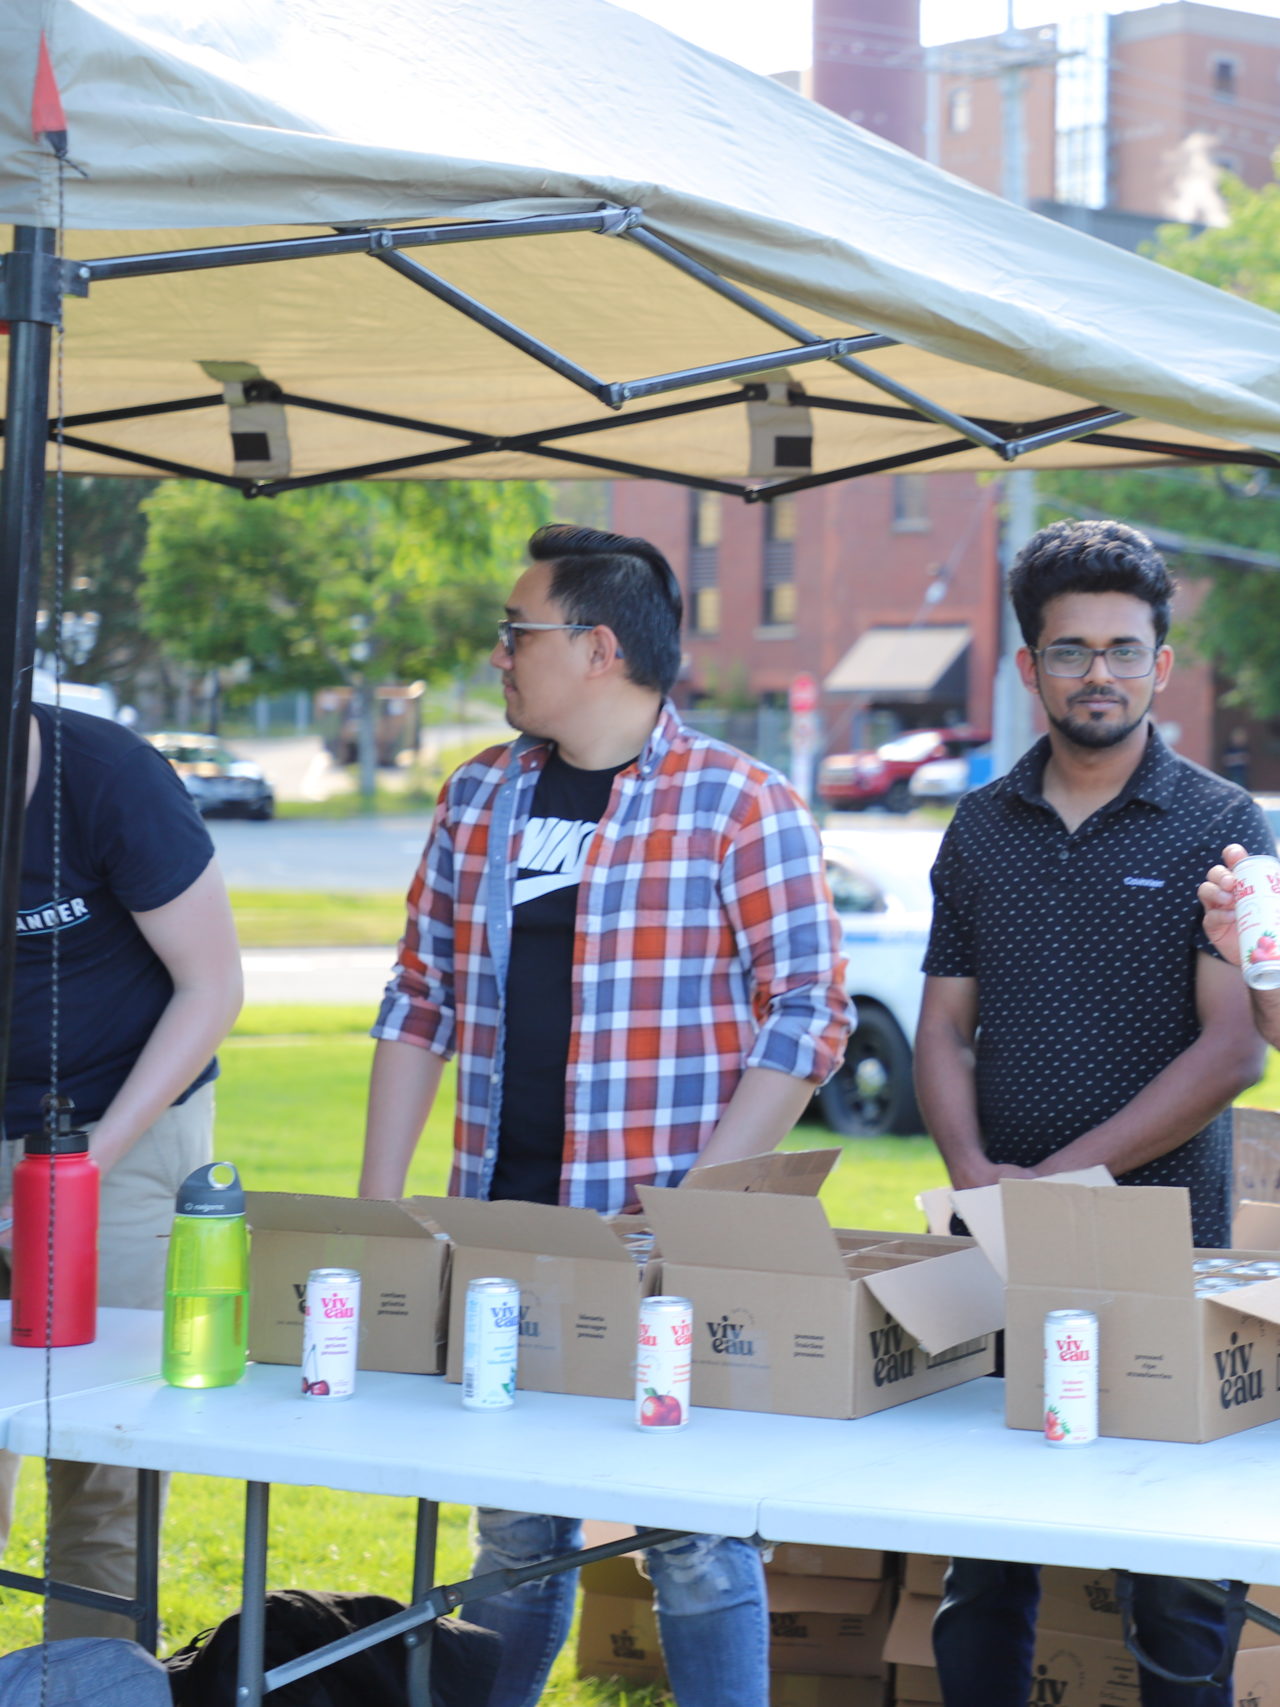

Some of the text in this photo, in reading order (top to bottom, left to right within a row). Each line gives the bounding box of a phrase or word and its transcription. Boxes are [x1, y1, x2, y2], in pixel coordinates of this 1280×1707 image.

[321, 1293, 350, 1308] viv
[490, 1301, 516, 1318] viv
[324, 1306, 355, 1319] eau
[706, 1315, 745, 1339] viv
[711, 1337, 755, 1357] eau
[1055, 1335, 1083, 1352] viv
[1059, 1349, 1090, 1362] eau
[1214, 1331, 1254, 1381] viv
[873, 1348, 915, 1387] eau
[1220, 1369, 1264, 1409] eau
